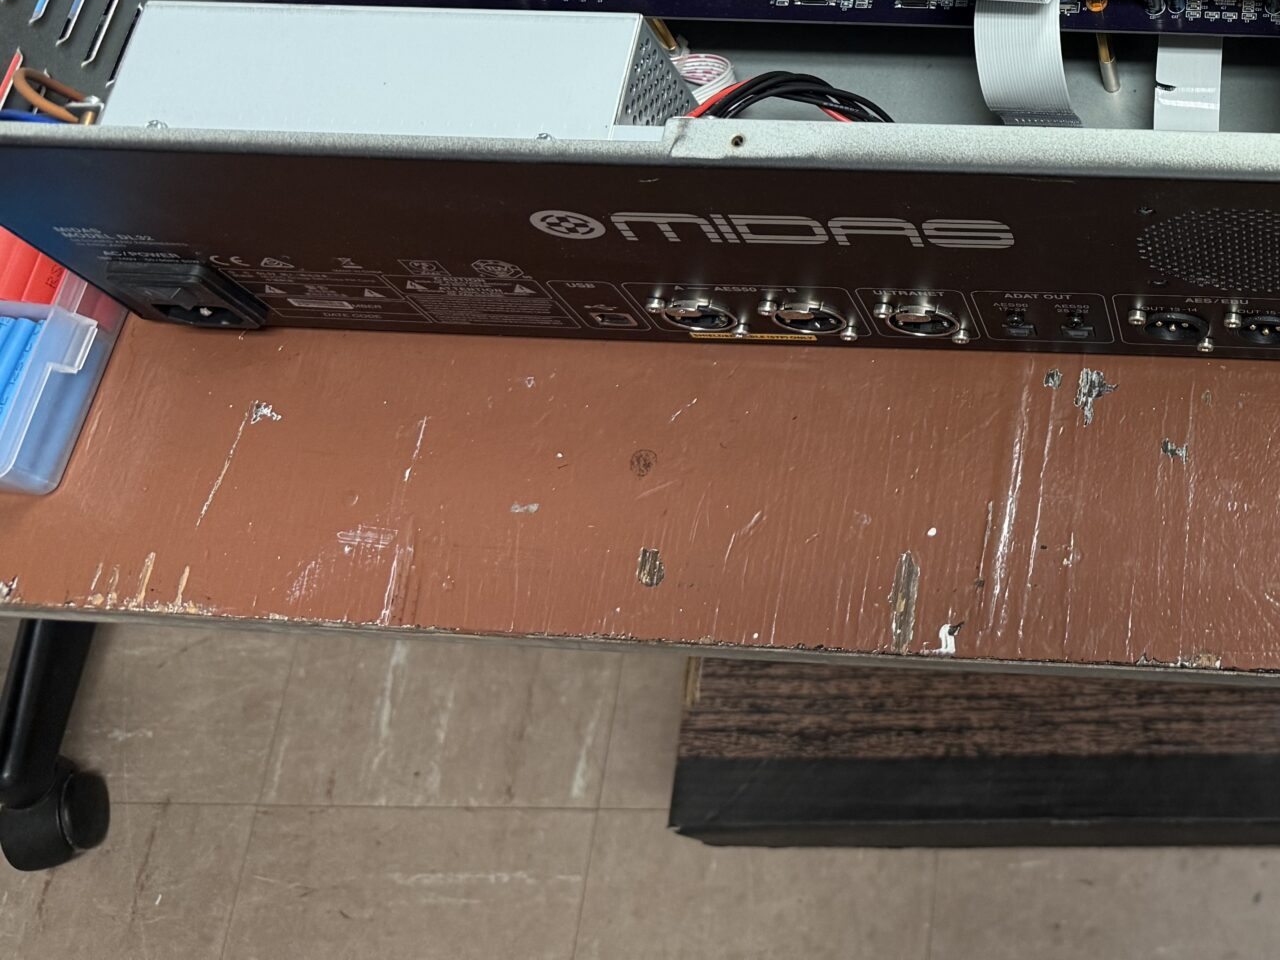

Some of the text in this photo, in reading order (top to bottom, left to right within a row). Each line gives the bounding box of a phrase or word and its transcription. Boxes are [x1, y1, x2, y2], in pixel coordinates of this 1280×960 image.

[610, 211, 1015, 249] MIDAS
[872, 288, 944, 298] ULTRANET
[1004, 291, 1072, 301] ADAT OUT
[1185, 296, 1249, 307] AES/EBU
